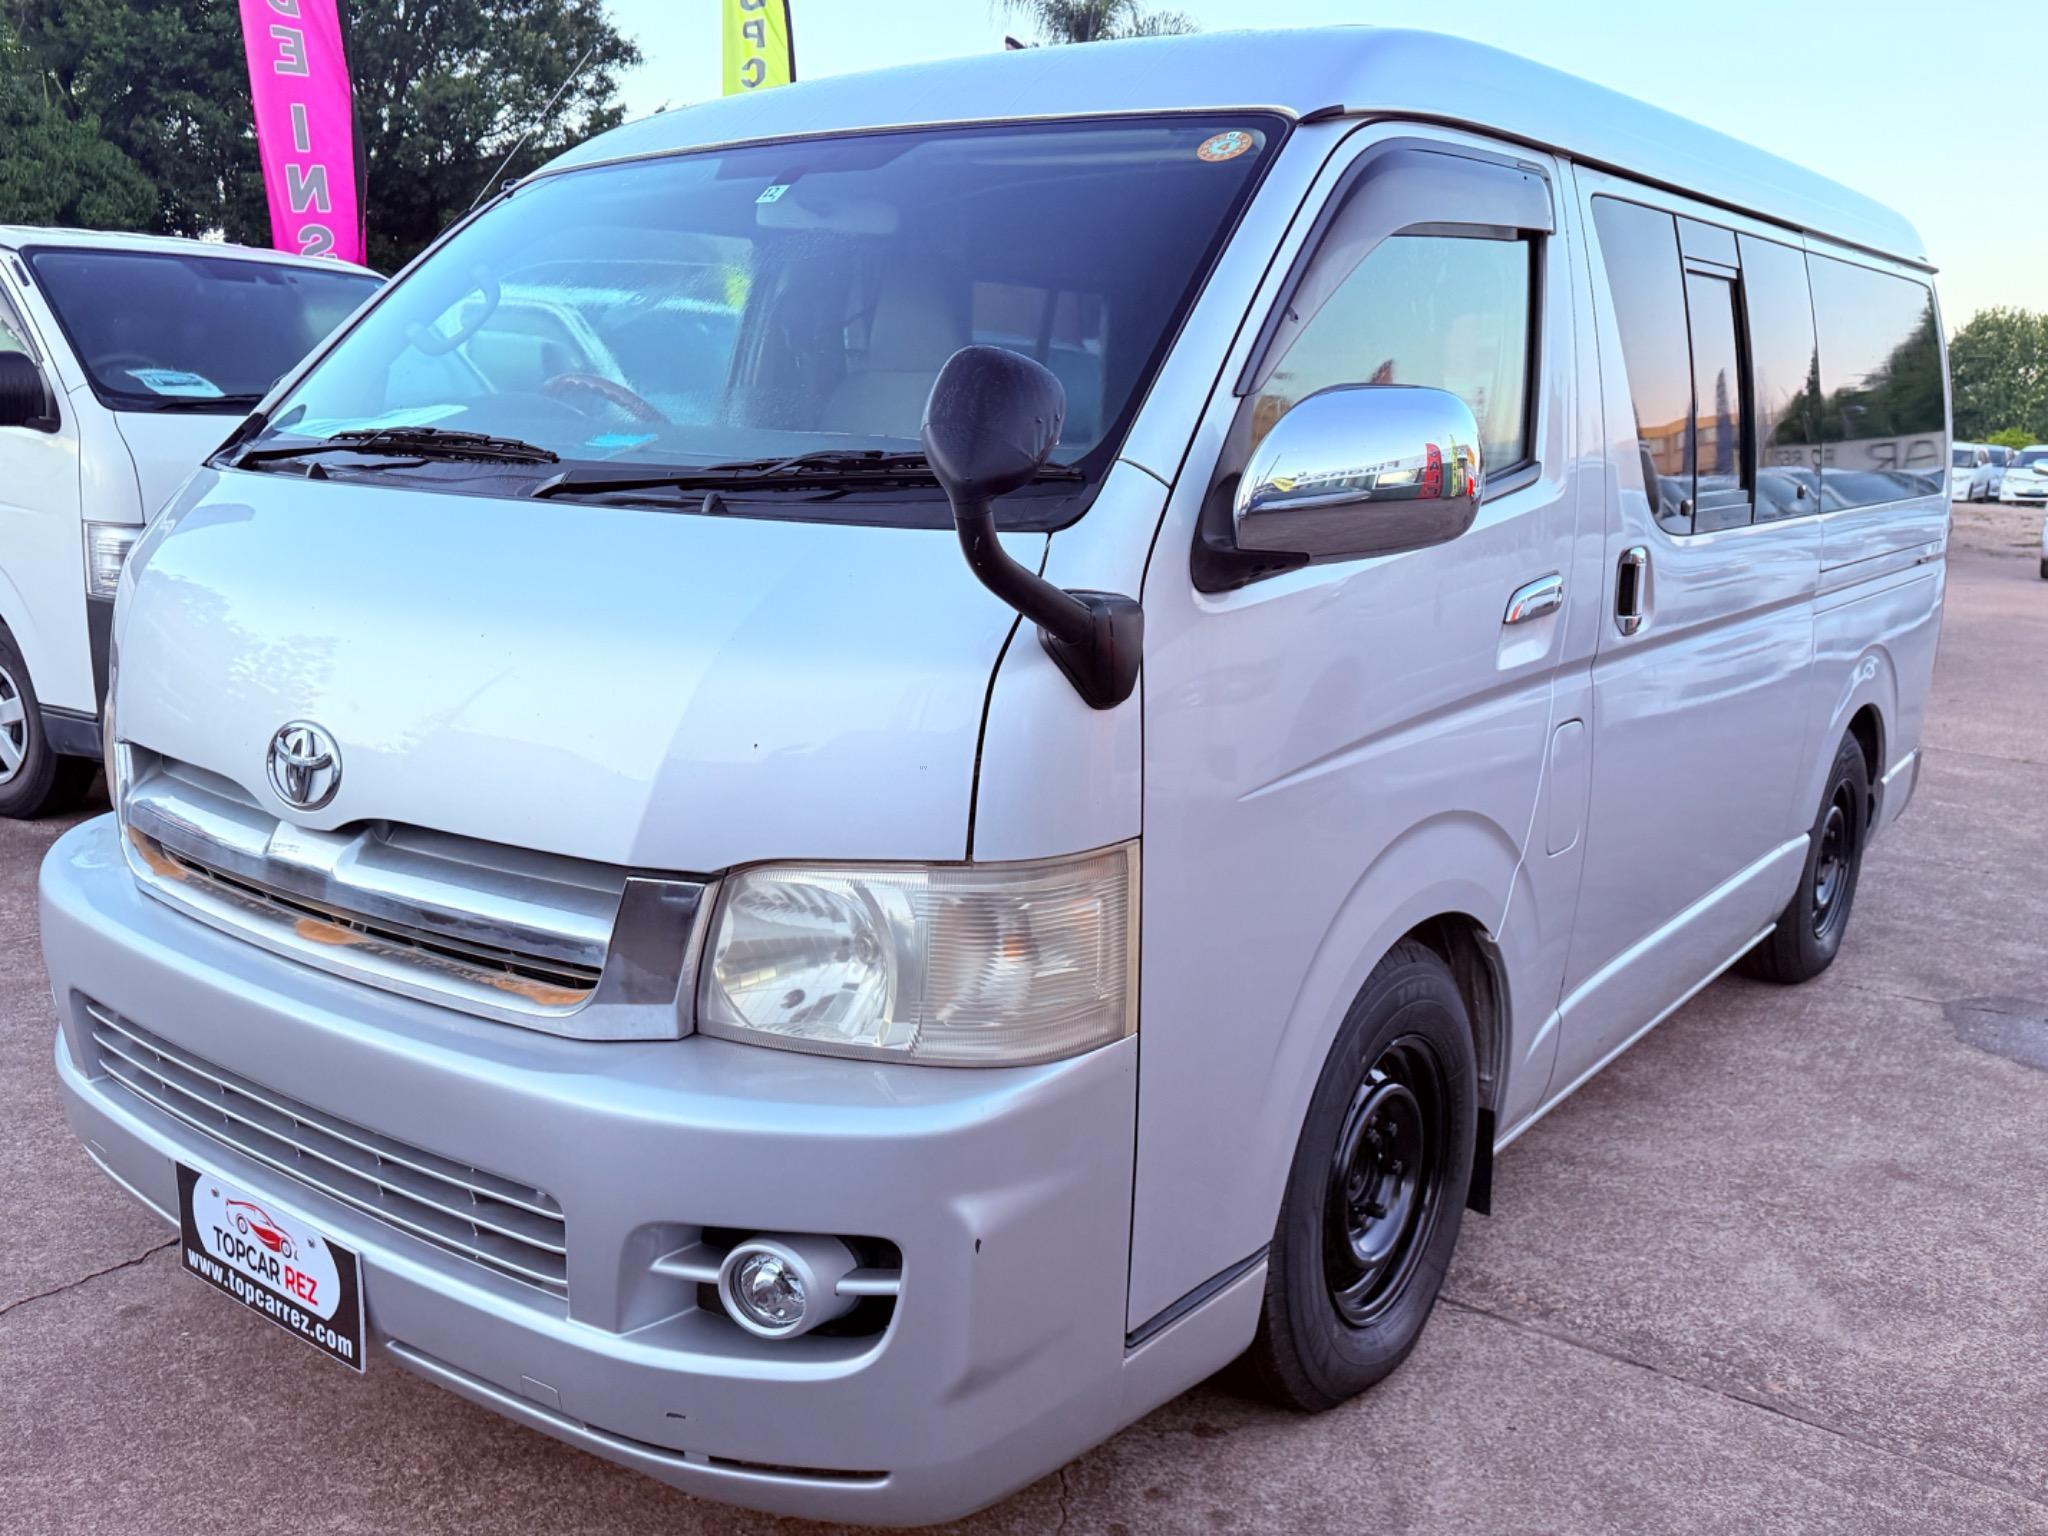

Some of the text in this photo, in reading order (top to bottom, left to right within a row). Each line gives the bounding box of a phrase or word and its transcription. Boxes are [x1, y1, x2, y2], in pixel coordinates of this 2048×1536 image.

[187, 1248, 353, 1359] www.topcarrez.com
[213, 1226, 319, 1306] TOPCAR REZ
